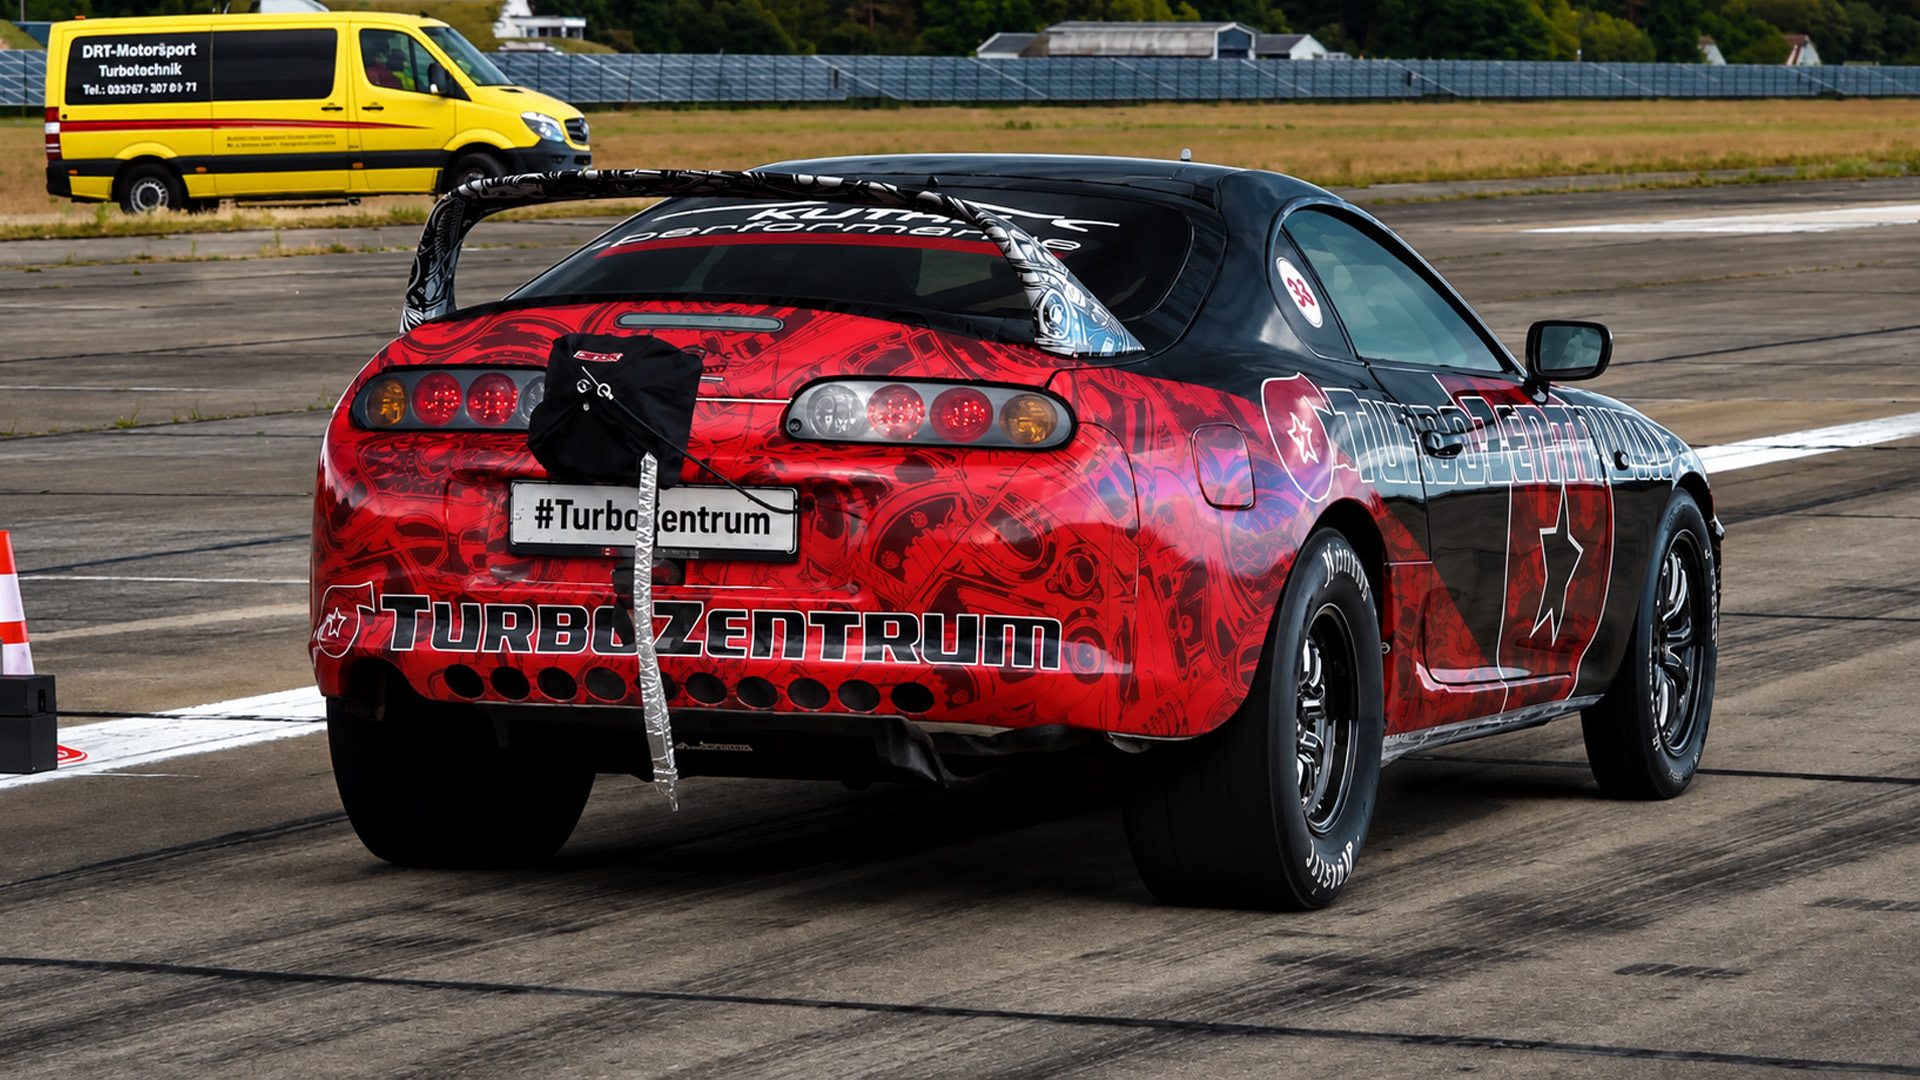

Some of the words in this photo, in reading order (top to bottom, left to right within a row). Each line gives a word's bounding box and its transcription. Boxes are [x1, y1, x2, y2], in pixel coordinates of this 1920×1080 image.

[82, 43, 197, 59] DRT-Motorsport
[82, 84, 106, 95] Tel.:
[589, 220, 1081, 251] performane
[535, 499, 770, 535] #Turboentrum
